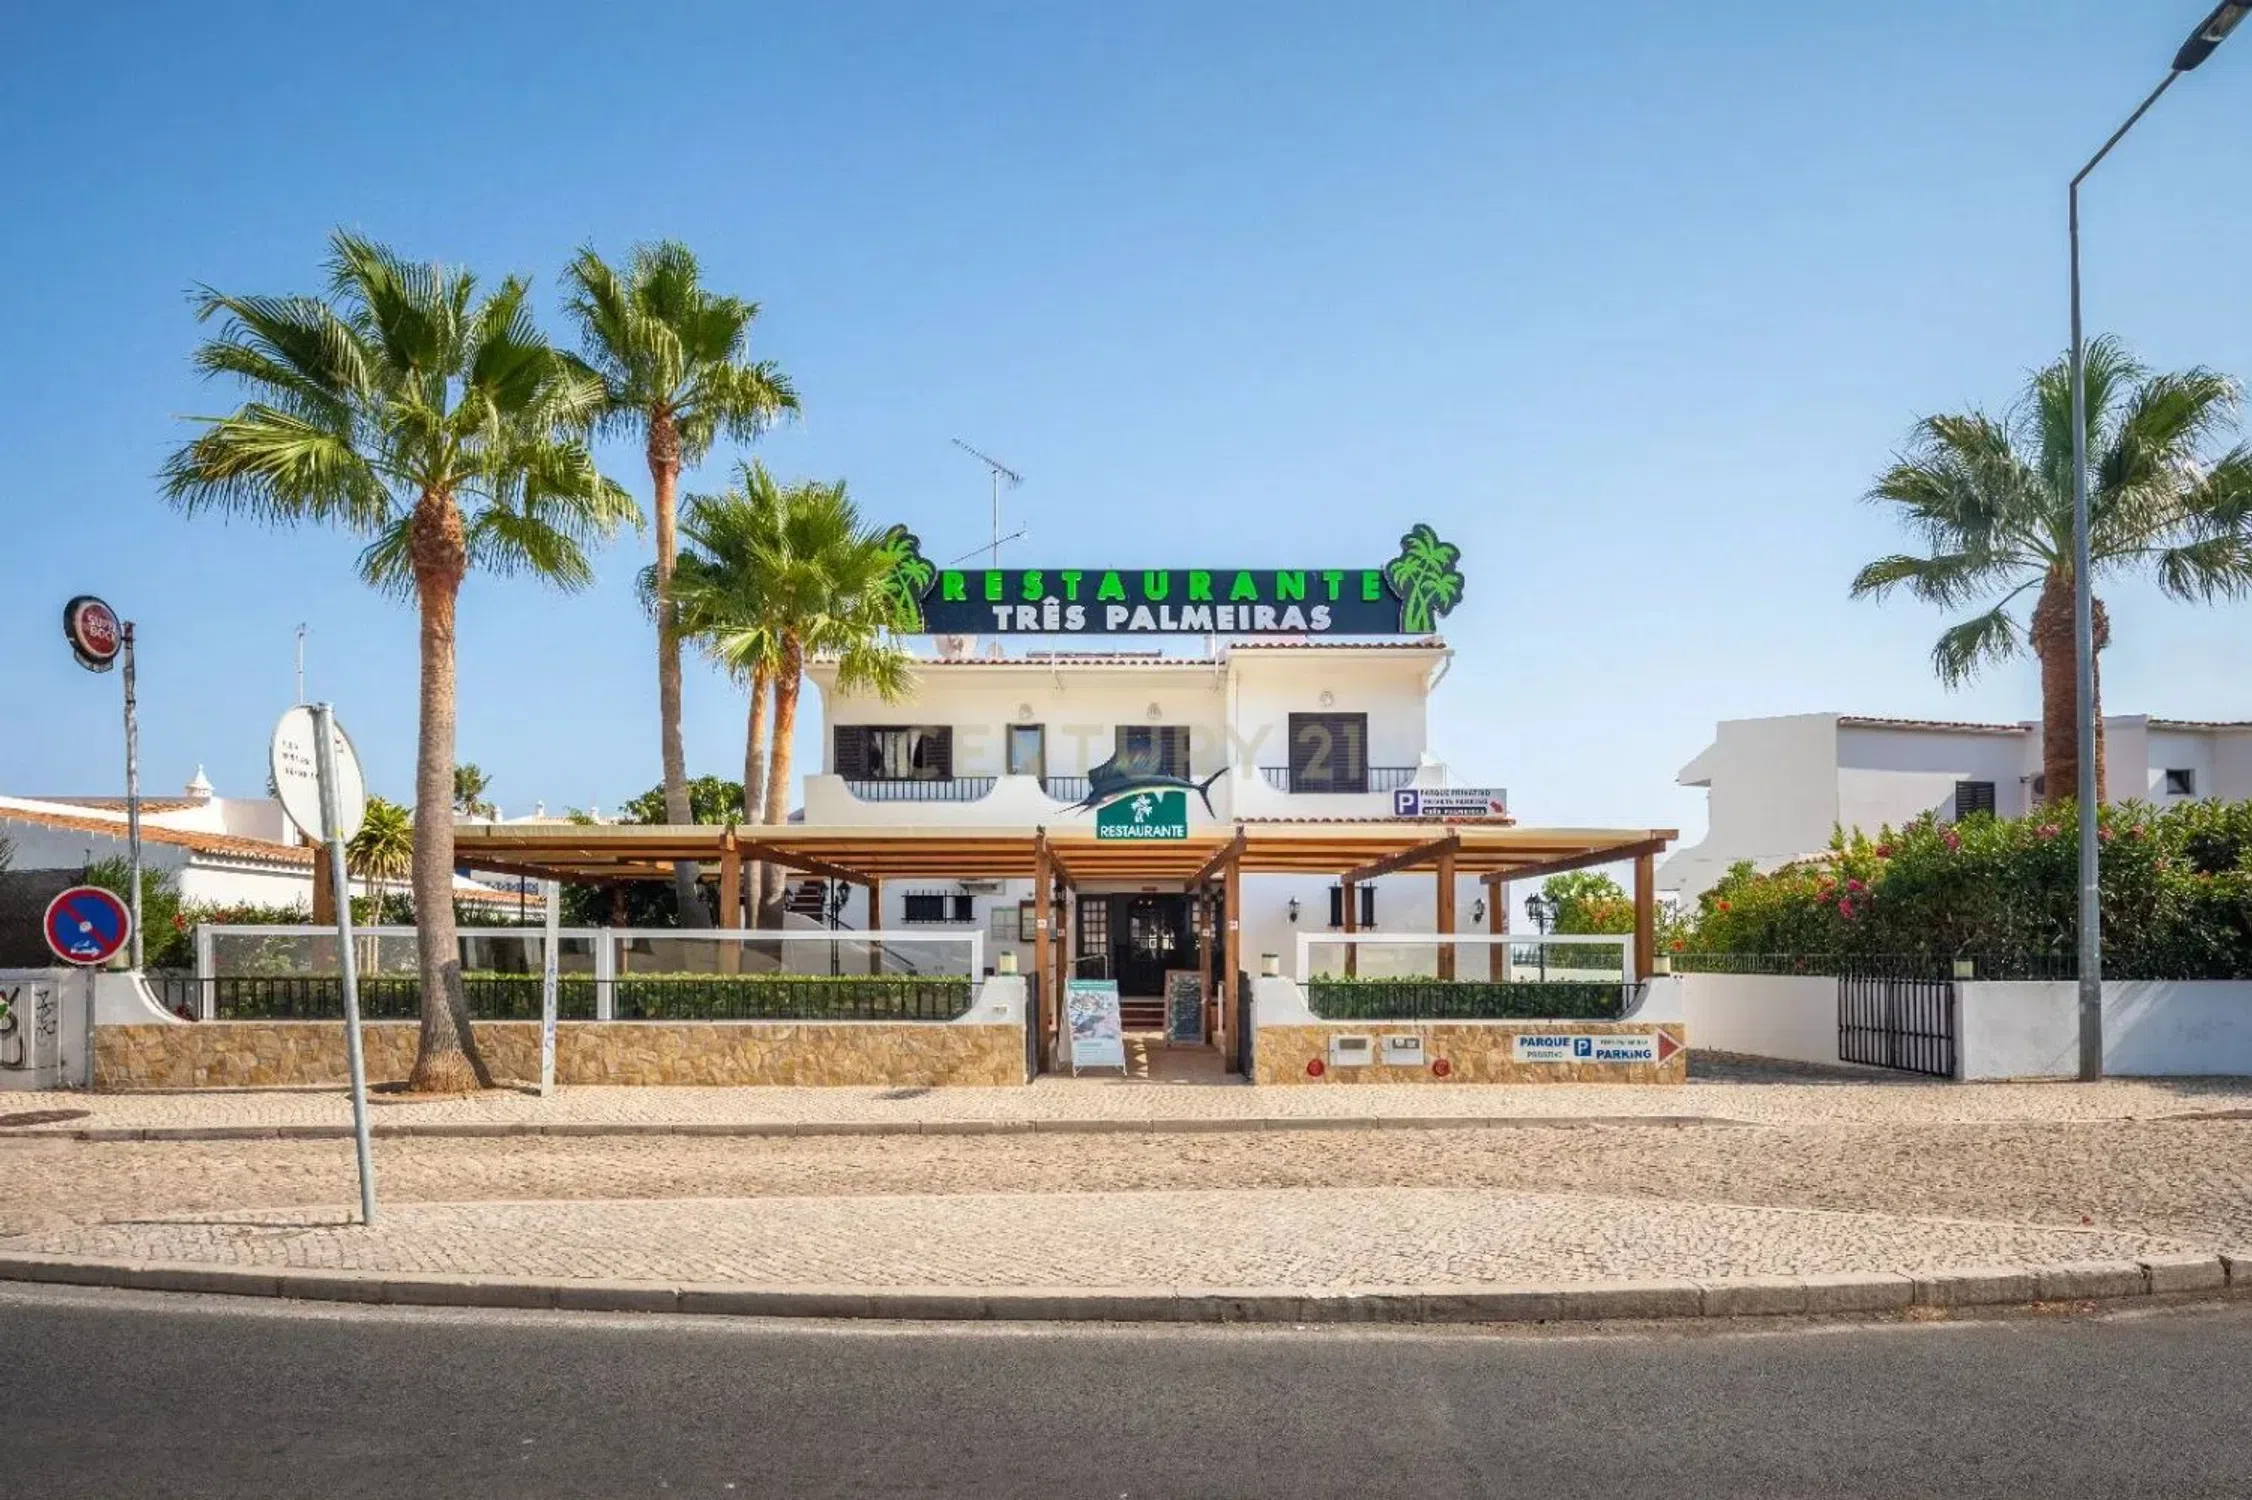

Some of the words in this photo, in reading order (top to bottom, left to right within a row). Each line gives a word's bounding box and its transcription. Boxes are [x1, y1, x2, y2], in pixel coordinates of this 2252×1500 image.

[941, 570, 1382, 601] RESTAURANTE
[993, 597, 1086, 632] TRÊS
[1106, 604, 1333, 632] PALMEIRAS
[1399, 793, 1415, 813] P
[1100, 825, 1184, 837] RESTAURANTE
[1519, 1037, 1571, 1047] PARQUE
[1577, 1038, 1588, 1055] P
[1596, 1049, 1652, 1060] PARKING
